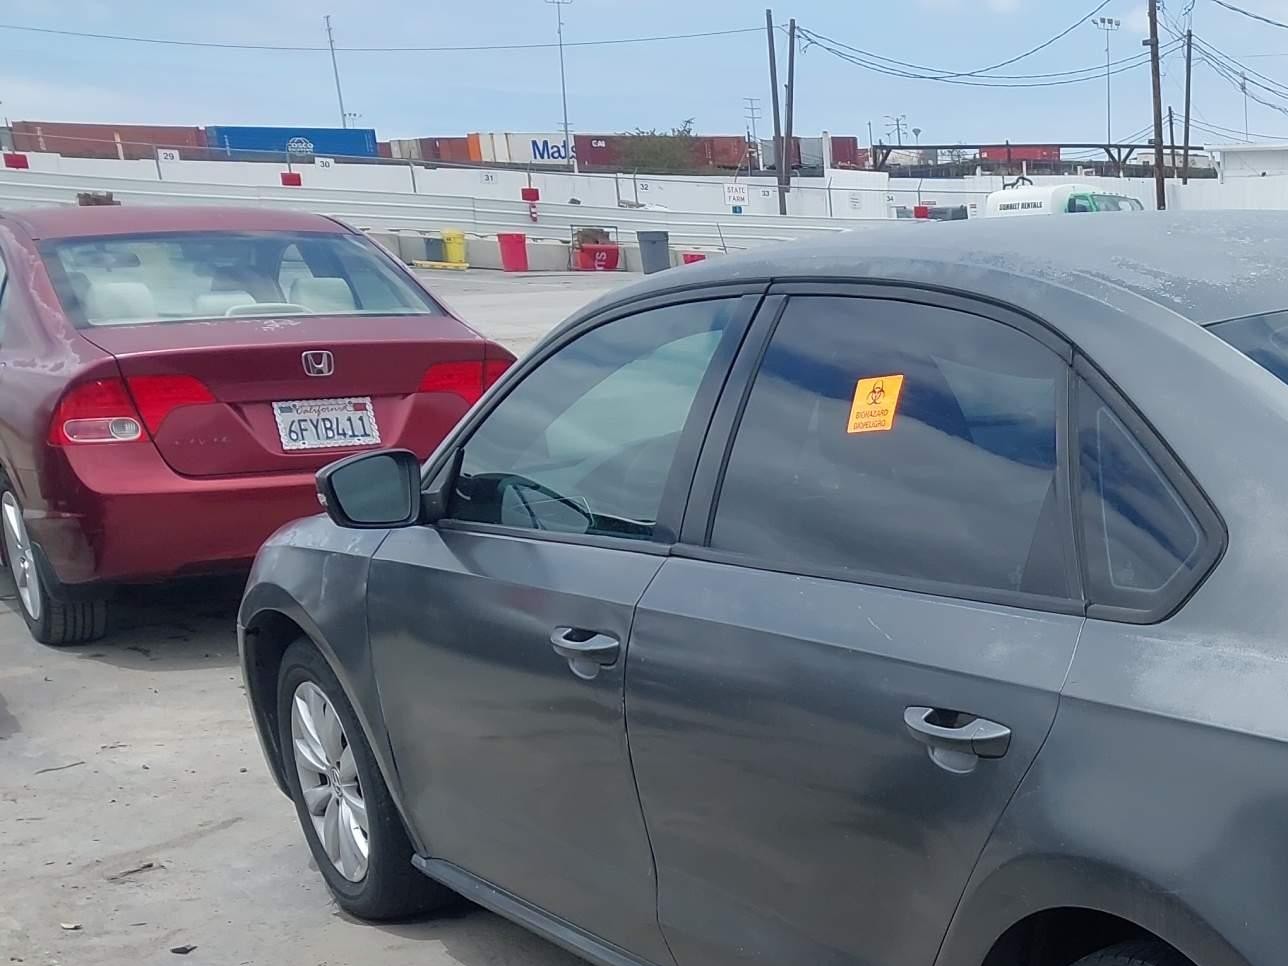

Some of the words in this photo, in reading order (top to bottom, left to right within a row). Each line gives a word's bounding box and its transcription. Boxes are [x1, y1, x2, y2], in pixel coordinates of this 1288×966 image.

[163, 152, 175, 160] 29
[320, 160, 330, 168] 30
[640, 183, 649, 191] 32
[727, 186, 745, 194] STATE
[296, 402, 353, 416] California
[288, 415, 371, 442] 6FYB411
